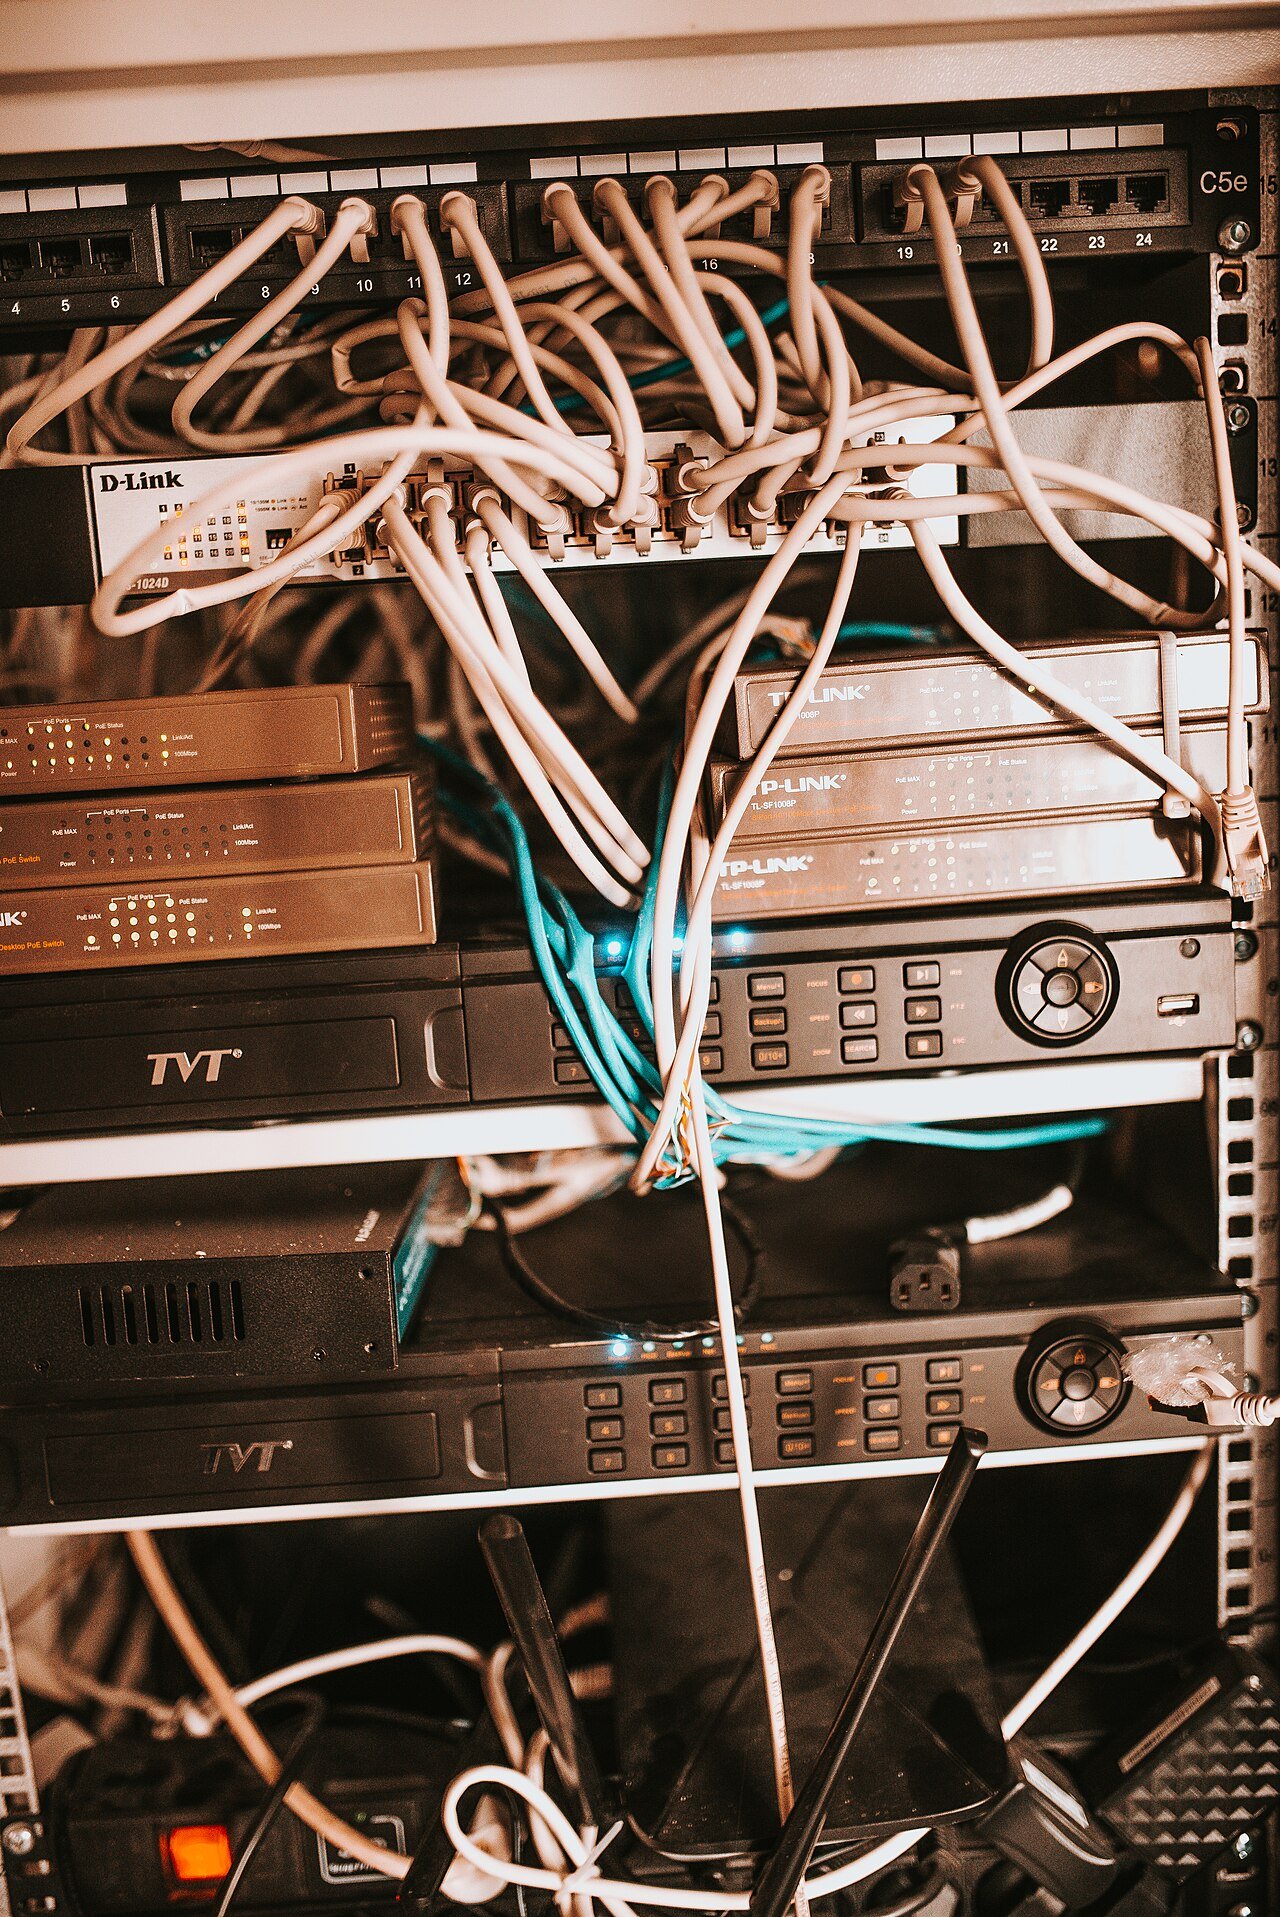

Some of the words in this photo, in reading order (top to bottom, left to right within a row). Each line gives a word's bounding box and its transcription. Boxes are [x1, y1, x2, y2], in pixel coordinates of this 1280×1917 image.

[1200, 171, 1248, 194] C5e
[1260, 175, 1277, 195] 15
[1041, 238, 1058, 252] 22
[1088, 236, 1106, 249] 23
[1136, 233, 1153, 246] 24
[897, 246, 913, 260] 19
[993, 241, 1009, 254] 21
[702, 259, 718, 270] 16
[356, 279, 373, 292] 10
[407, 276, 422, 289] 11
[455, 273, 472, 286] 12
[261, 285, 270, 298] 8
[311, 283, 320, 295] 9
[11, 302, 21, 315] 4
[61, 299, 70, 312] 5
[110, 296, 120, 309] 6
[1259, 318, 1277, 338] 14
[1259, 458, 1278, 477] 13
[100, 470, 184, 492] D-Link
[127, 577, 169, 590] -1024D
[767, 685, 865, 707] TLINK
[751, 799, 797, 811] TL-SF1008P
[901, 808, 918, 816] Power
[18, 855, 41, 863] Switch
[719, 855, 809, 877] TP-LINK
[42, 940, 65, 948] Switch
[806, 980, 829, 988] FOCUS
[809, 1014, 831, 1022] SPEED
[844, 1044, 875, 1053] SEARCH
[147, 1048, 233, 1086] TVT
[570, 1067, 577, 1077] 7
[664, 1388, 672, 1399] 2
[200, 1441, 285, 1474] TVT
